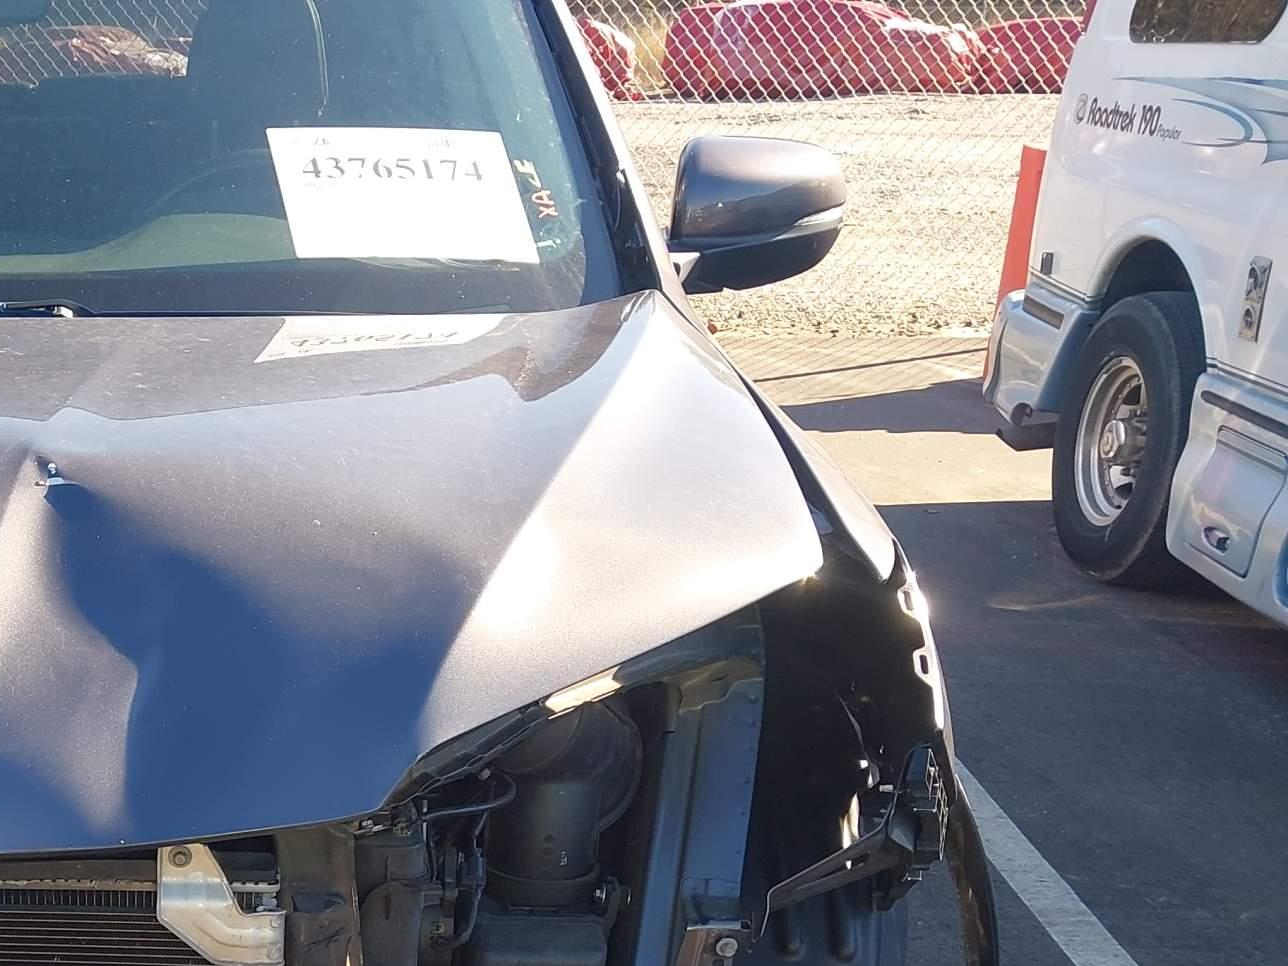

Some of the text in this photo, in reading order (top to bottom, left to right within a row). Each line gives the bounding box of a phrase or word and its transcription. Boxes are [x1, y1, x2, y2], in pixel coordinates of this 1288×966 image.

[1087, 97, 1182, 142] Roadtrek 190 Popular
[302, 156, 483, 181] 43765174
